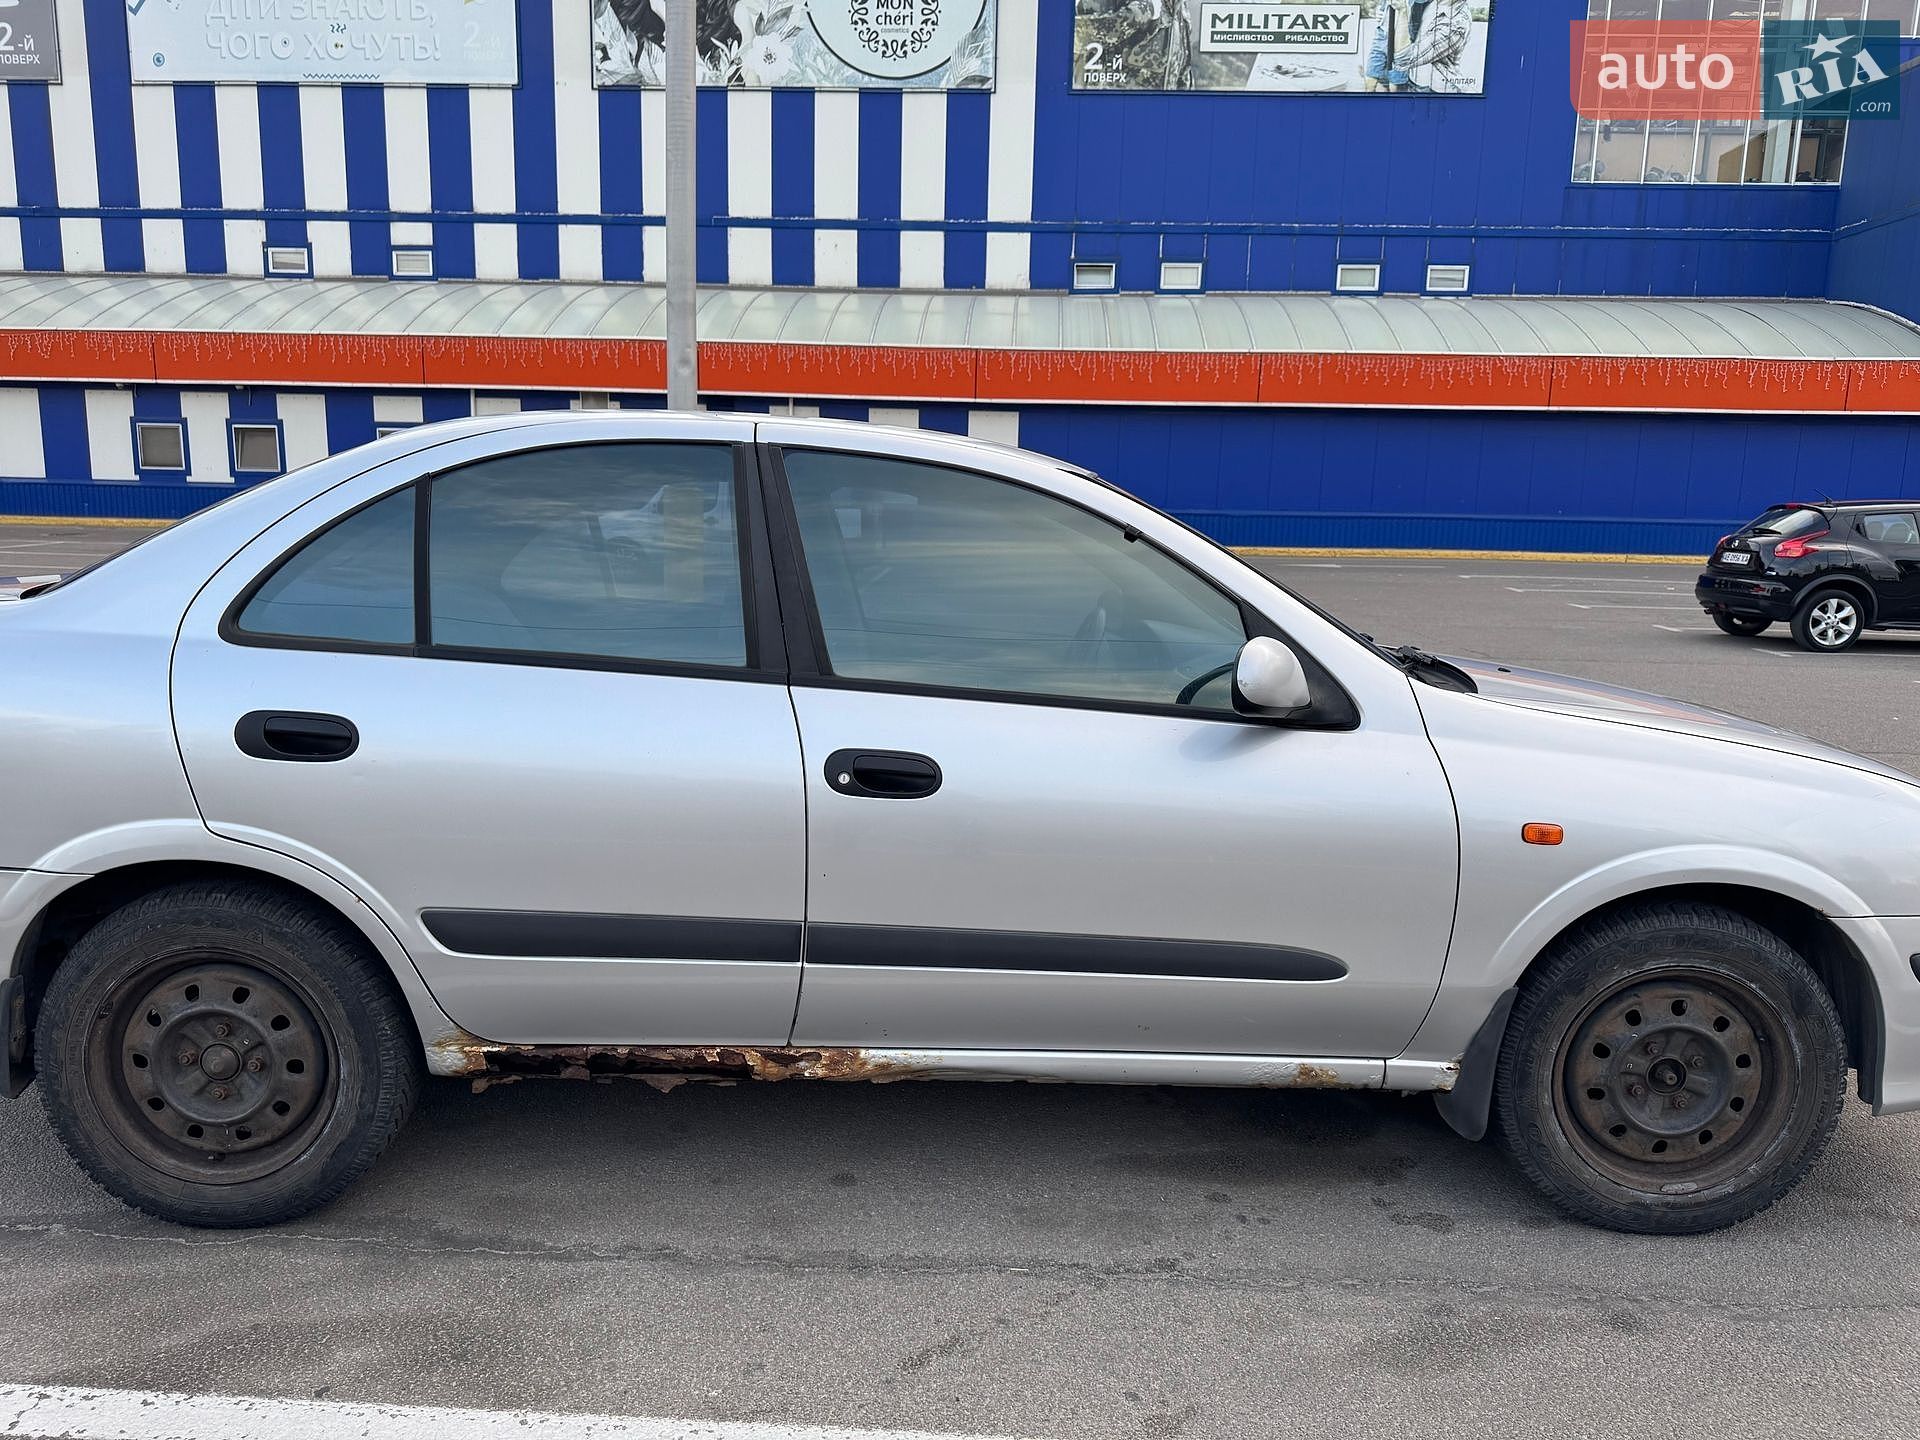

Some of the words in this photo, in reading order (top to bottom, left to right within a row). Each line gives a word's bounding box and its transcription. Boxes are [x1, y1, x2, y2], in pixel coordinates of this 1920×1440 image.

[876, 0, 914, 9] MON
[875, 11, 913, 25] chéri
[1210, 13, 1350, 30] MILITARY
[1213, 33, 1275, 42] МИСЛИВСТВО
[1284, 34, 1346, 43] РИБАЛЬСТВО
[205, 32, 296, 60] ЧОГО
[303, 31, 441, 61] ХОЧУТЬ!
[1083, 72, 1127, 83] ПОВЕРХ
